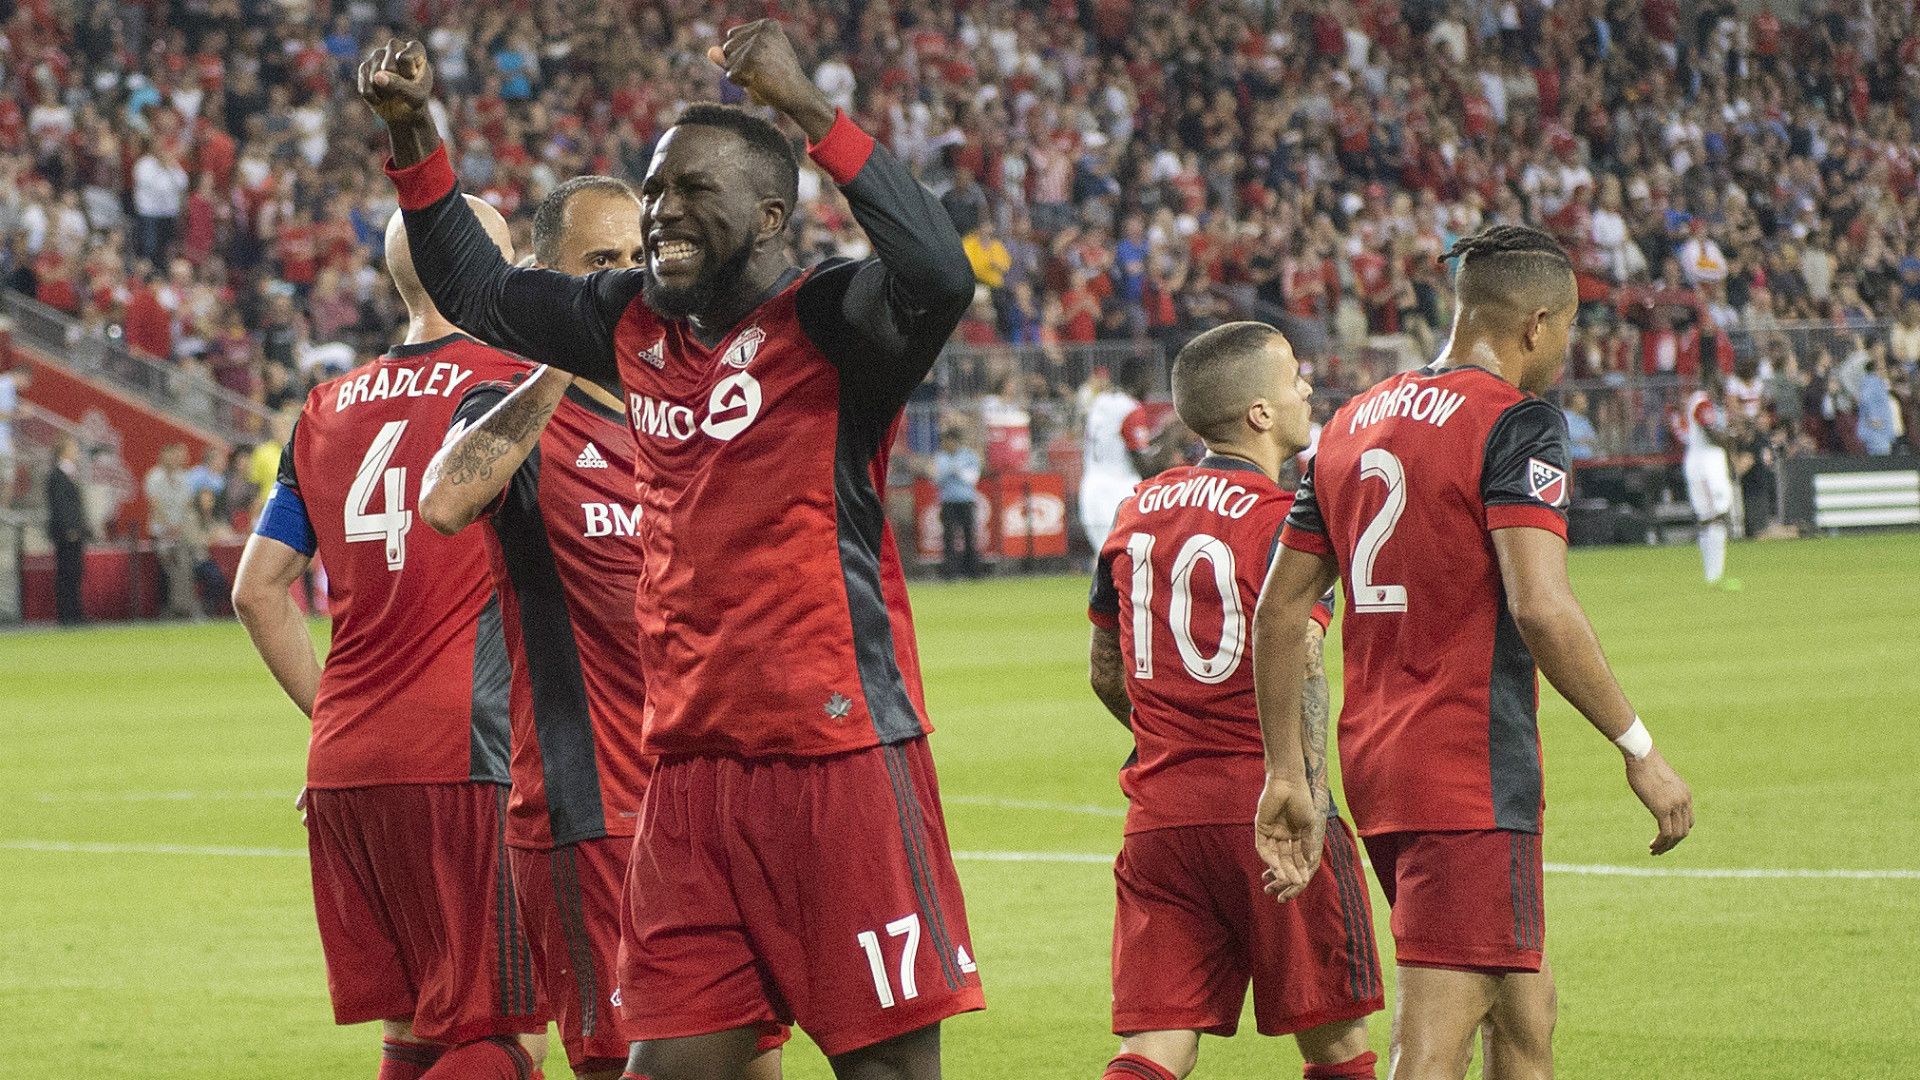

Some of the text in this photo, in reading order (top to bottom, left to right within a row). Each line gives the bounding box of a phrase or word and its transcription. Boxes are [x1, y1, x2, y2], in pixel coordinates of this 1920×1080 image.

[335, 362, 473, 412] BRADLEY
[1350, 383, 1466, 434] MORROW
[630, 392, 697, 440] BMO
[576, 459, 608, 469] adidas
[1533, 464, 1553, 479] MLS
[344, 419, 413, 571] 4
[580, 502, 643, 537] BM
[1138, 475, 1260, 519] GIOVINCO
[1352, 448, 1408, 613] 2
[1127, 532, 1246, 684] 10
[857, 912, 921, 1009] 17
